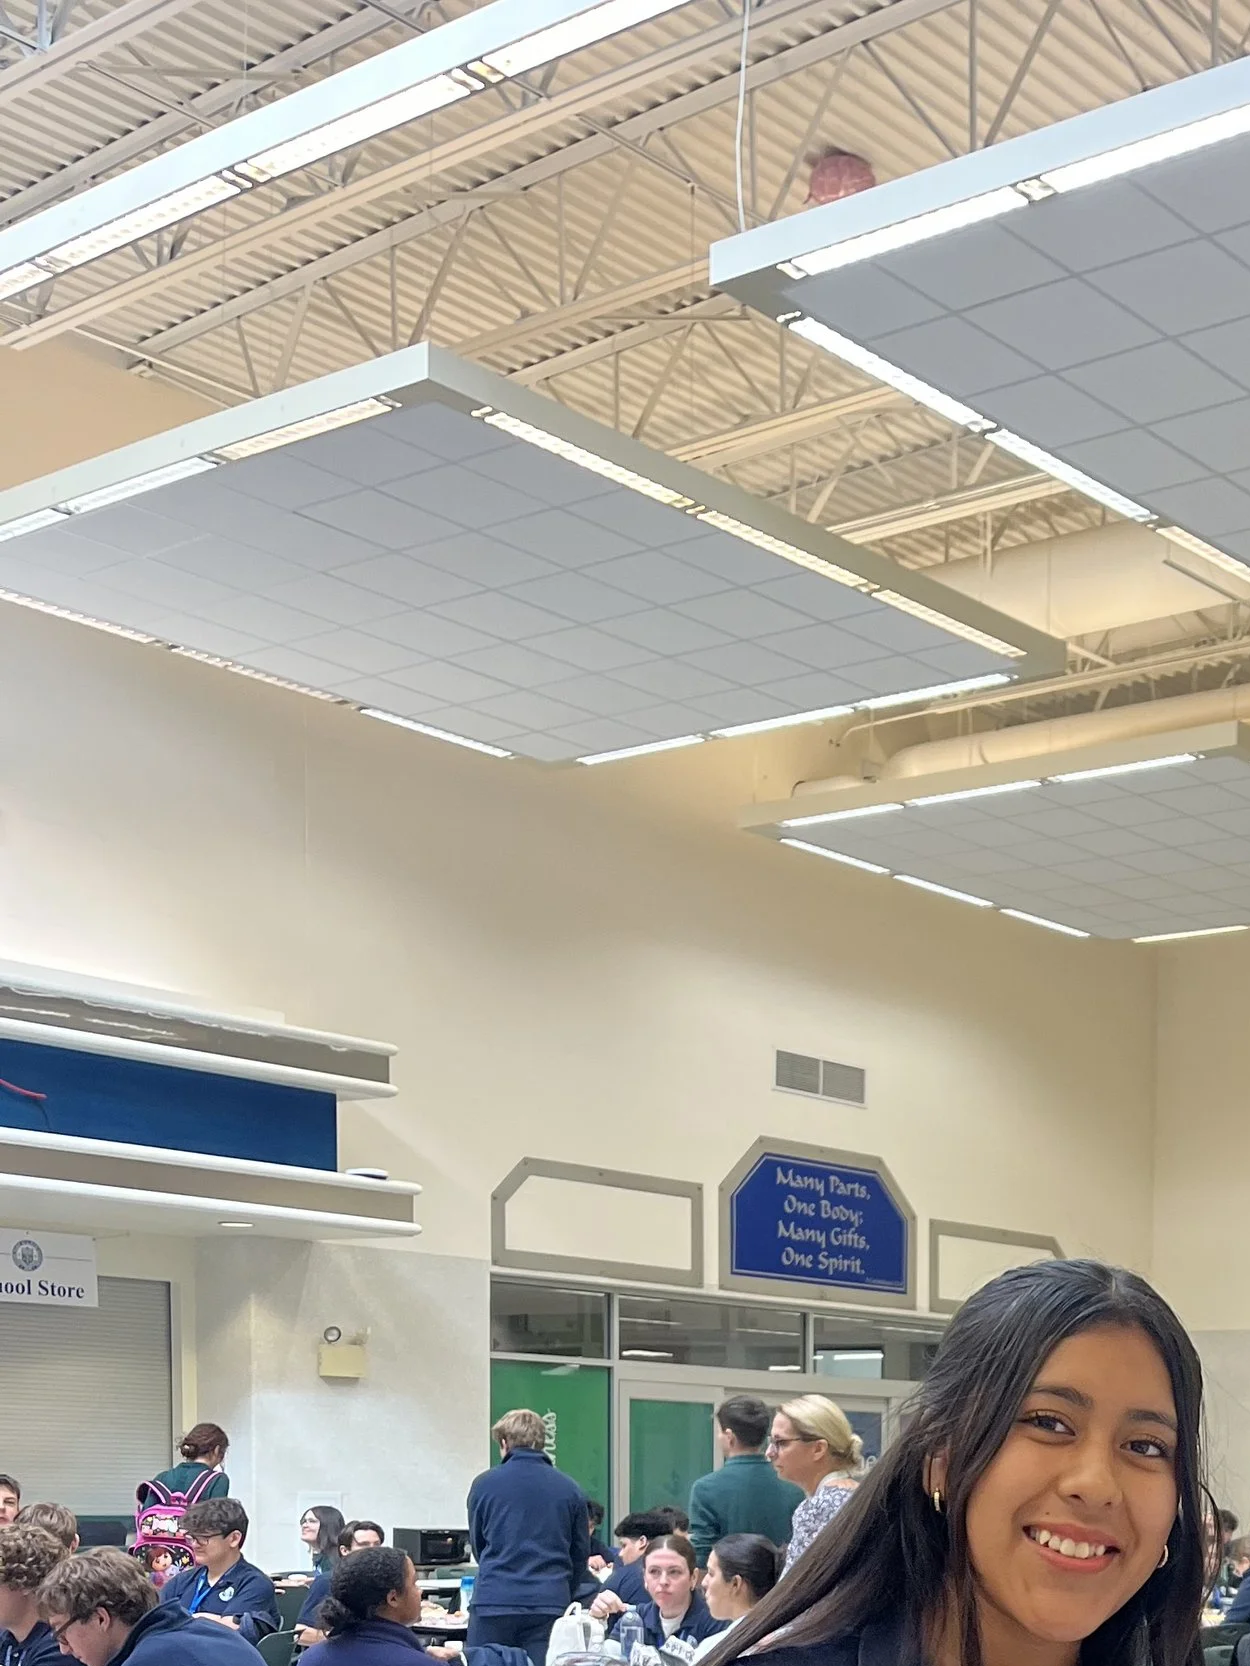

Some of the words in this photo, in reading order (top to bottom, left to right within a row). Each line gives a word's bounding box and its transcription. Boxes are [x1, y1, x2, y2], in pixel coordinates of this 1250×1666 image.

[776, 1167, 824, 1197] Many
[829, 1175, 871, 1200] Parts,
[784, 1194, 815, 1217] One
[777, 1220, 825, 1248] Many
[830, 1227, 870, 1250] Gifts,
[781, 1247, 812, 1268] One
[818, 1251, 865, 1275] Spirit.
[38, 1279, 84, 1299] Store
